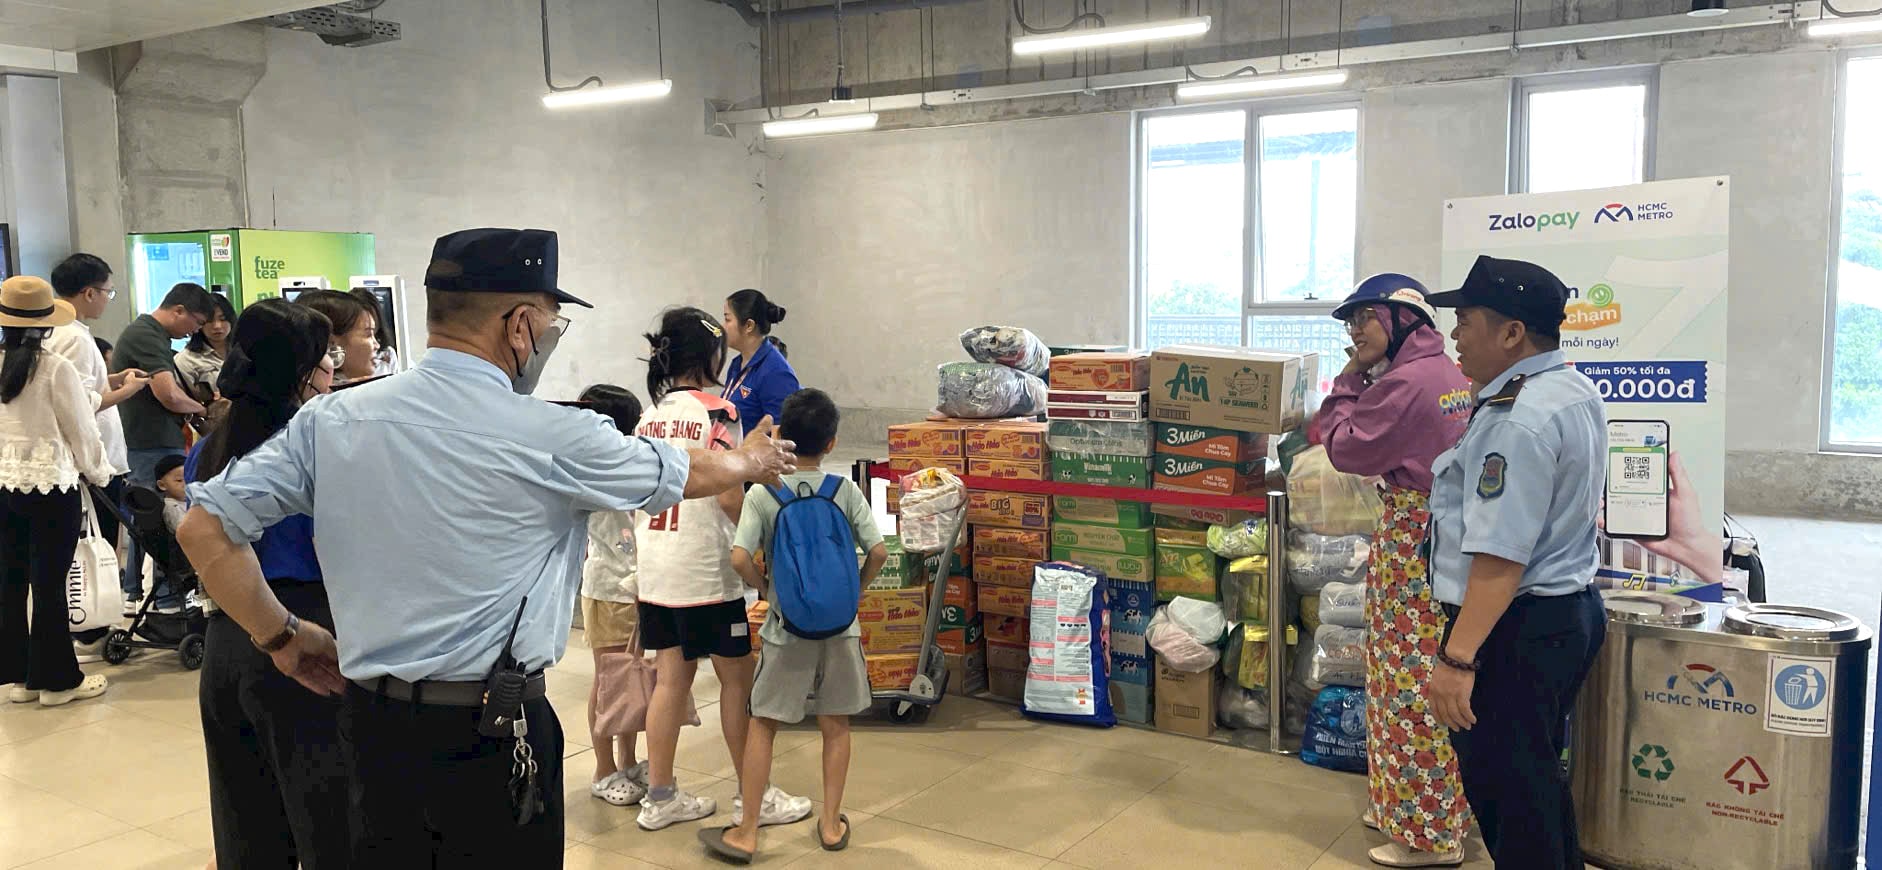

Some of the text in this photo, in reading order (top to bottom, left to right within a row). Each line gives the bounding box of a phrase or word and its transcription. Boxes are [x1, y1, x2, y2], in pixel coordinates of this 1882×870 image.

[1637, 203, 1667, 212] HCMC
[1637, 212, 1673, 220] METRO
[1489, 212, 1580, 231] Zalopay
[254, 256, 285, 270] fuze
[255, 269, 278, 279] tea
[1613, 367, 1637, 375] 50%
[1657, 367, 1671, 375] đa
[1644, 690, 1757, 715] HCMC METRO
